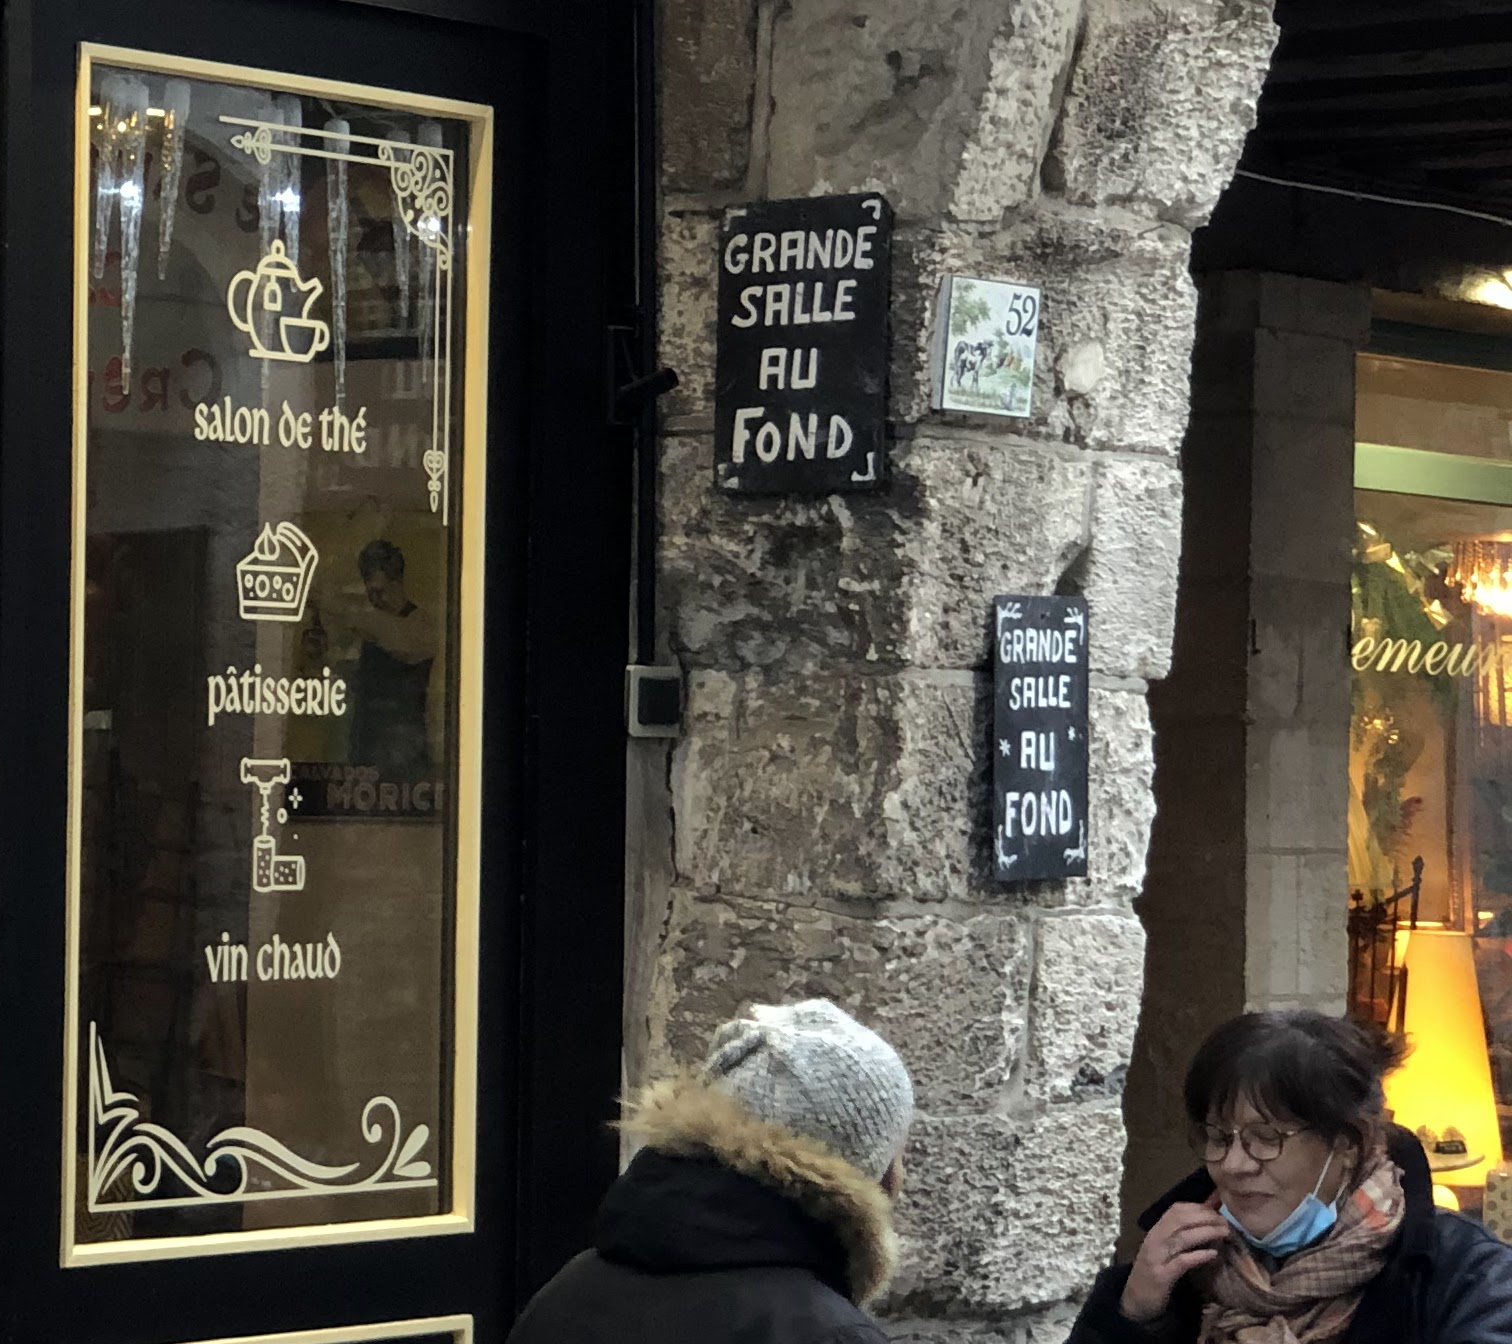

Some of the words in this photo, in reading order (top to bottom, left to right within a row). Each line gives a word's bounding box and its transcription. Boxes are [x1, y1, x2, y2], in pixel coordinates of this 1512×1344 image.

[723, 225, 878, 274] GRANDE
[731, 279, 858, 328] SALLE
[1005, 291, 1037, 338] 52
[759, 346, 819, 390] AU
[194, 396, 270, 445] salon
[278, 399, 313, 449] de
[318, 405, 368, 454] thé
[731, 407, 854, 464] FOND
[999, 628, 1077, 664] GRANDE
[207, 663, 348, 726] pâtisserie
[1009, 674, 1071, 710] SALLE
[1020, 730, 1056, 771] AU
[1004, 789, 1073, 837] FOND
[204, 931, 248, 983] vin
[255, 933, 342, 981] chaud
